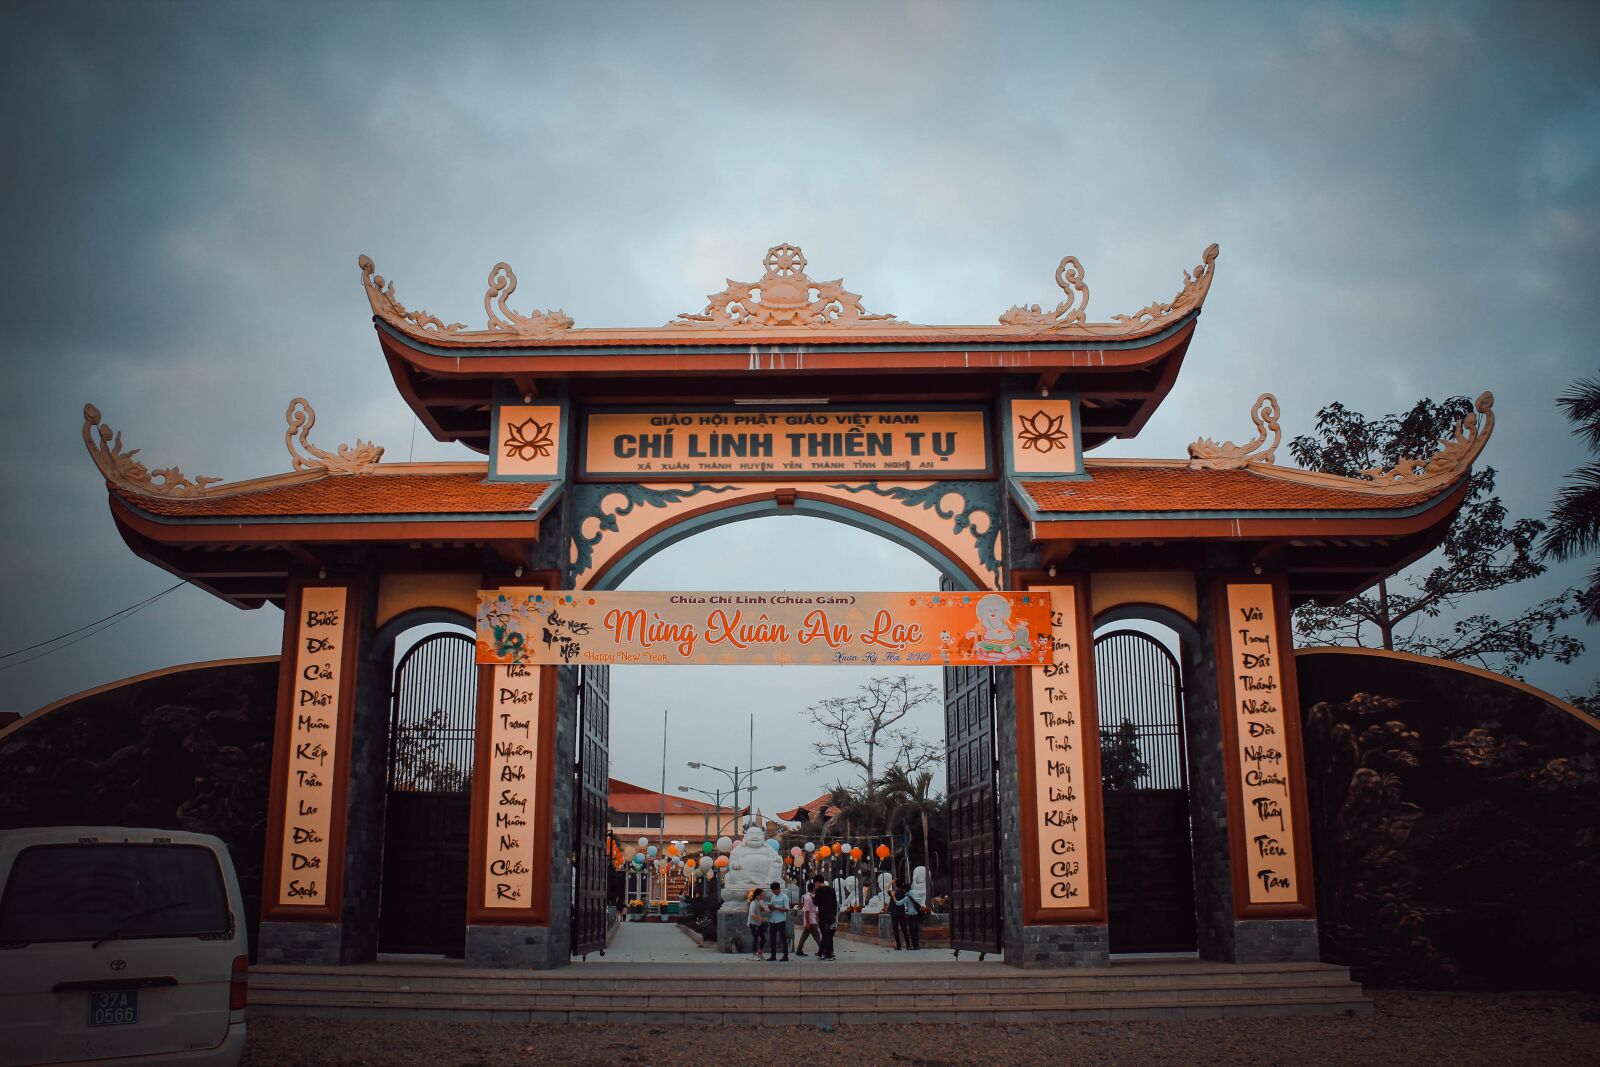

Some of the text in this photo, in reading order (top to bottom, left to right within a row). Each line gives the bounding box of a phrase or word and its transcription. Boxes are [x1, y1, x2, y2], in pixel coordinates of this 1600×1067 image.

[650, 413, 919, 428] GIÁO HỘI PHẬT GIÁO VIỆT NAM
[614, 428, 675, 458] CHÍ
[786, 425, 893, 457] THIỀN
[905, 432, 957, 461] TỰ
[661, 461, 690, 471] XUÂN
[740, 461, 774, 472] HUYỆN
[884, 460, 911, 471] NGHỆ
[670, 596, 706, 604] Chùa
[709, 596, 732, 604] Chí
[736, 596, 767, 604] Linh
[1240, 606, 1263, 622] Vào
[603, 608, 923, 656] Mừng Xuân An Lạc
[1239, 629, 1271, 654] Trong
[584, 652, 615, 662] Happy
[617, 652, 640, 661] New
[500, 687, 533, 704] Phật
[1044, 687, 1068, 703] Trời
[1242, 699, 1277, 716] Nhiều
[297, 714, 330, 733] Muôn
[500, 713, 530, 739] Trang
[1040, 711, 1075, 728] Thanh
[1247, 721, 1275, 737] Đời
[1045, 735, 1072, 751] Tịnh
[494, 741, 533, 763] Nghiêm
[1244, 745, 1282, 770] Nghiệp
[500, 765, 525, 782] Ánh
[1047, 759, 1071, 782] Mây
[499, 789, 527, 814] Sáng
[1049, 786, 1076, 802] Lành
[298, 799, 318, 816] Lao
[496, 812, 526, 829] Muôn
[1044, 808, 1078, 832] Khắp
[1253, 834, 1287, 859] Tiêu
[490, 860, 529, 876] Chiếu
[287, 880, 318, 898] Sạch
[1256, 869, 1290, 893] Tan
[1050, 881, 1078, 899] Che
[100, 992, 128, 1008] 37A
[95, 1007, 134, 1023] 0566
